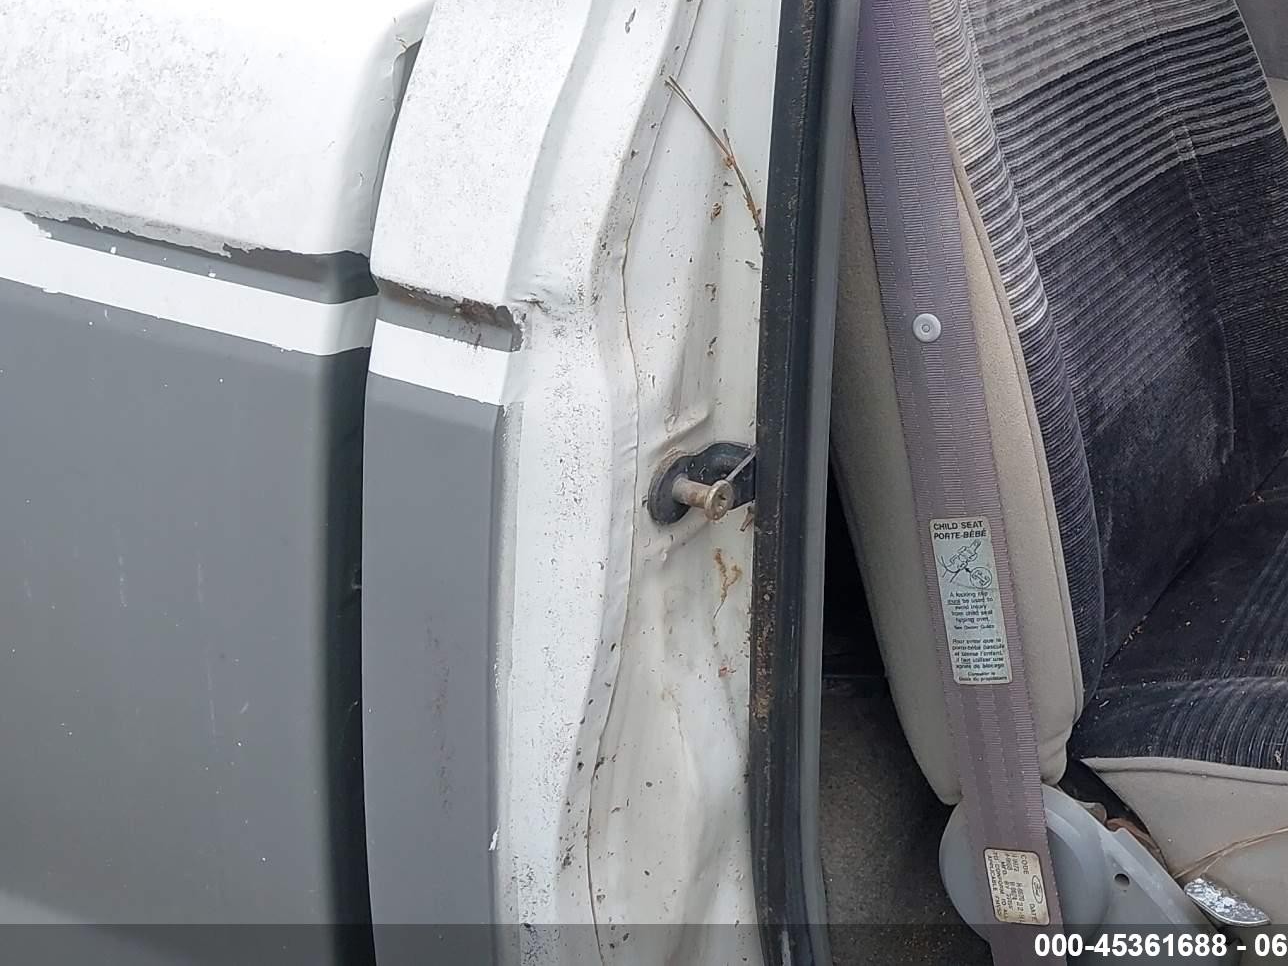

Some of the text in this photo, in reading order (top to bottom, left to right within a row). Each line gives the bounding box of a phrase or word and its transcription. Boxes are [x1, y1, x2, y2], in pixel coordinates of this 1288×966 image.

[933, 520, 983, 531] CHILD SEAT
[933, 528, 987, 540] PORTE-BÉBÉ
[1020, 855, 1029, 875] CODE
[1029, 903, 1038, 922] DATE
